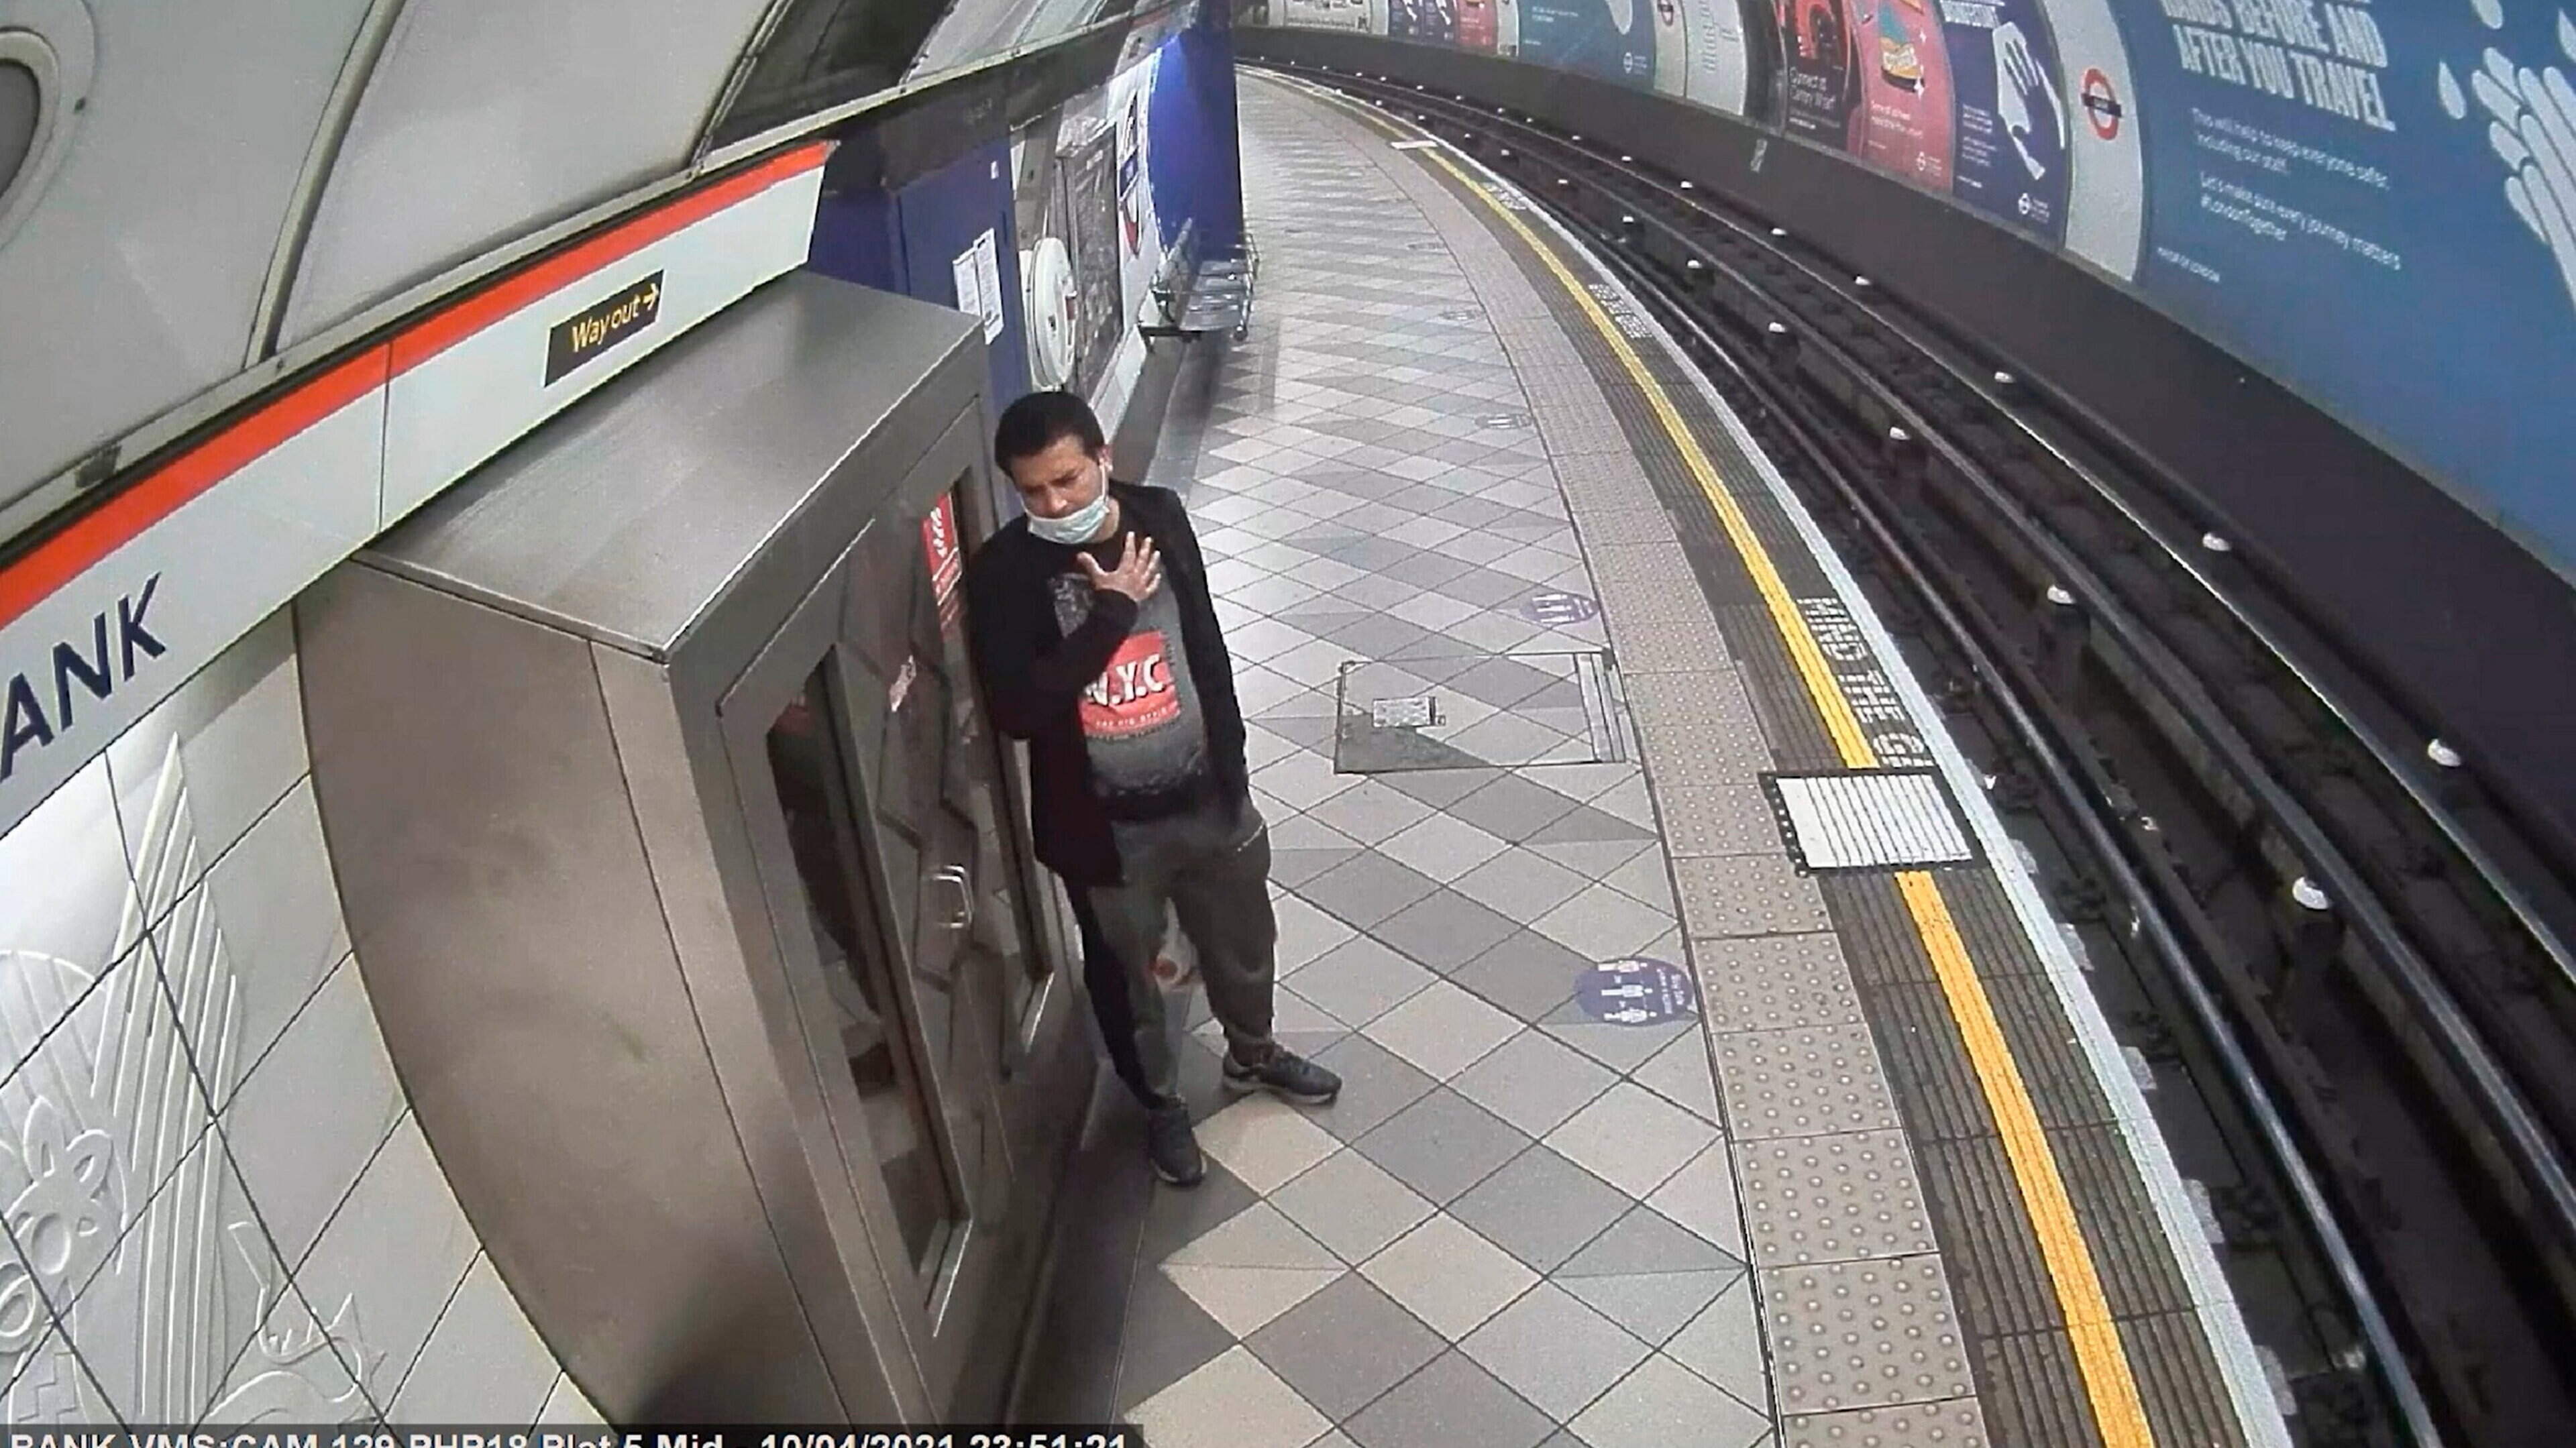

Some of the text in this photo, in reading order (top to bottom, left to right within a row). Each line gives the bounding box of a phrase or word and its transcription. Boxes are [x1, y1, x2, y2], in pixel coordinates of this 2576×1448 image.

[2172, 24, 2396, 131] AFTER YOU TRAVEL
[2232, 0, 2330, 53] BEFORE
[2324, 3, 2387, 68] AND
[572, 295, 641, 353] Way out
[1796, 597, 1868, 661] MIND
[1837, 669, 1905, 724] THE
